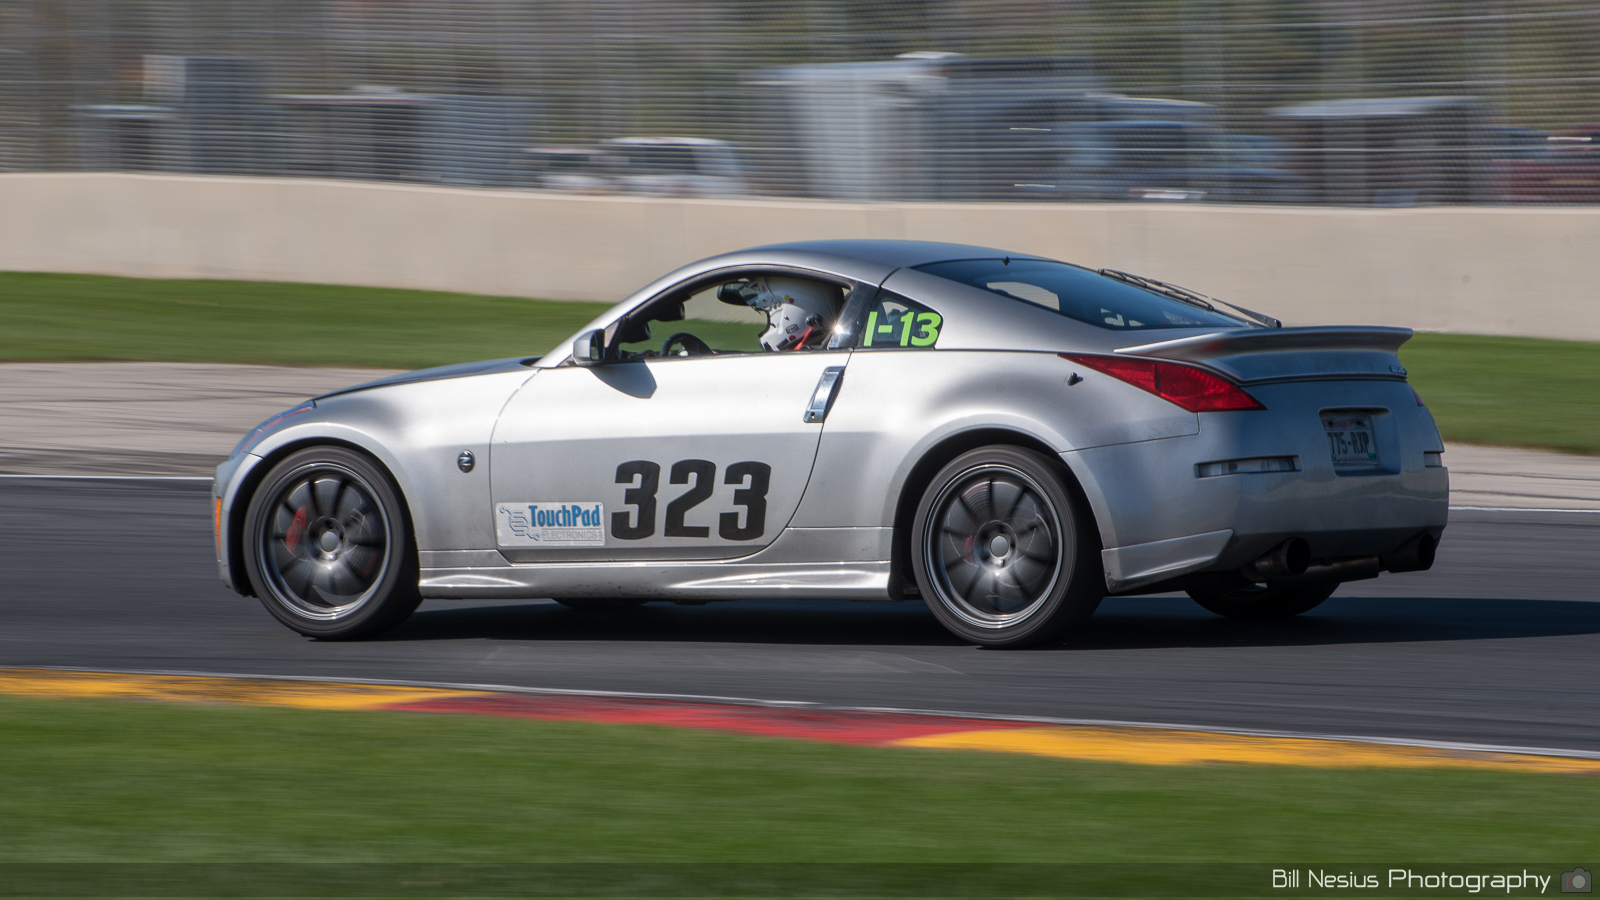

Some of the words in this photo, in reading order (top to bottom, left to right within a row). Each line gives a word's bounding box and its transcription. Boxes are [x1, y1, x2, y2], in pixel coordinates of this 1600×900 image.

[863, 311, 942, 347] I-13
[1327, 431, 1370, 455] 775-RXP
[611, 459, 772, 541] 323
[528, 504, 601, 527] TouchPad
[542, 530, 598, 540] ELECTRONICS
